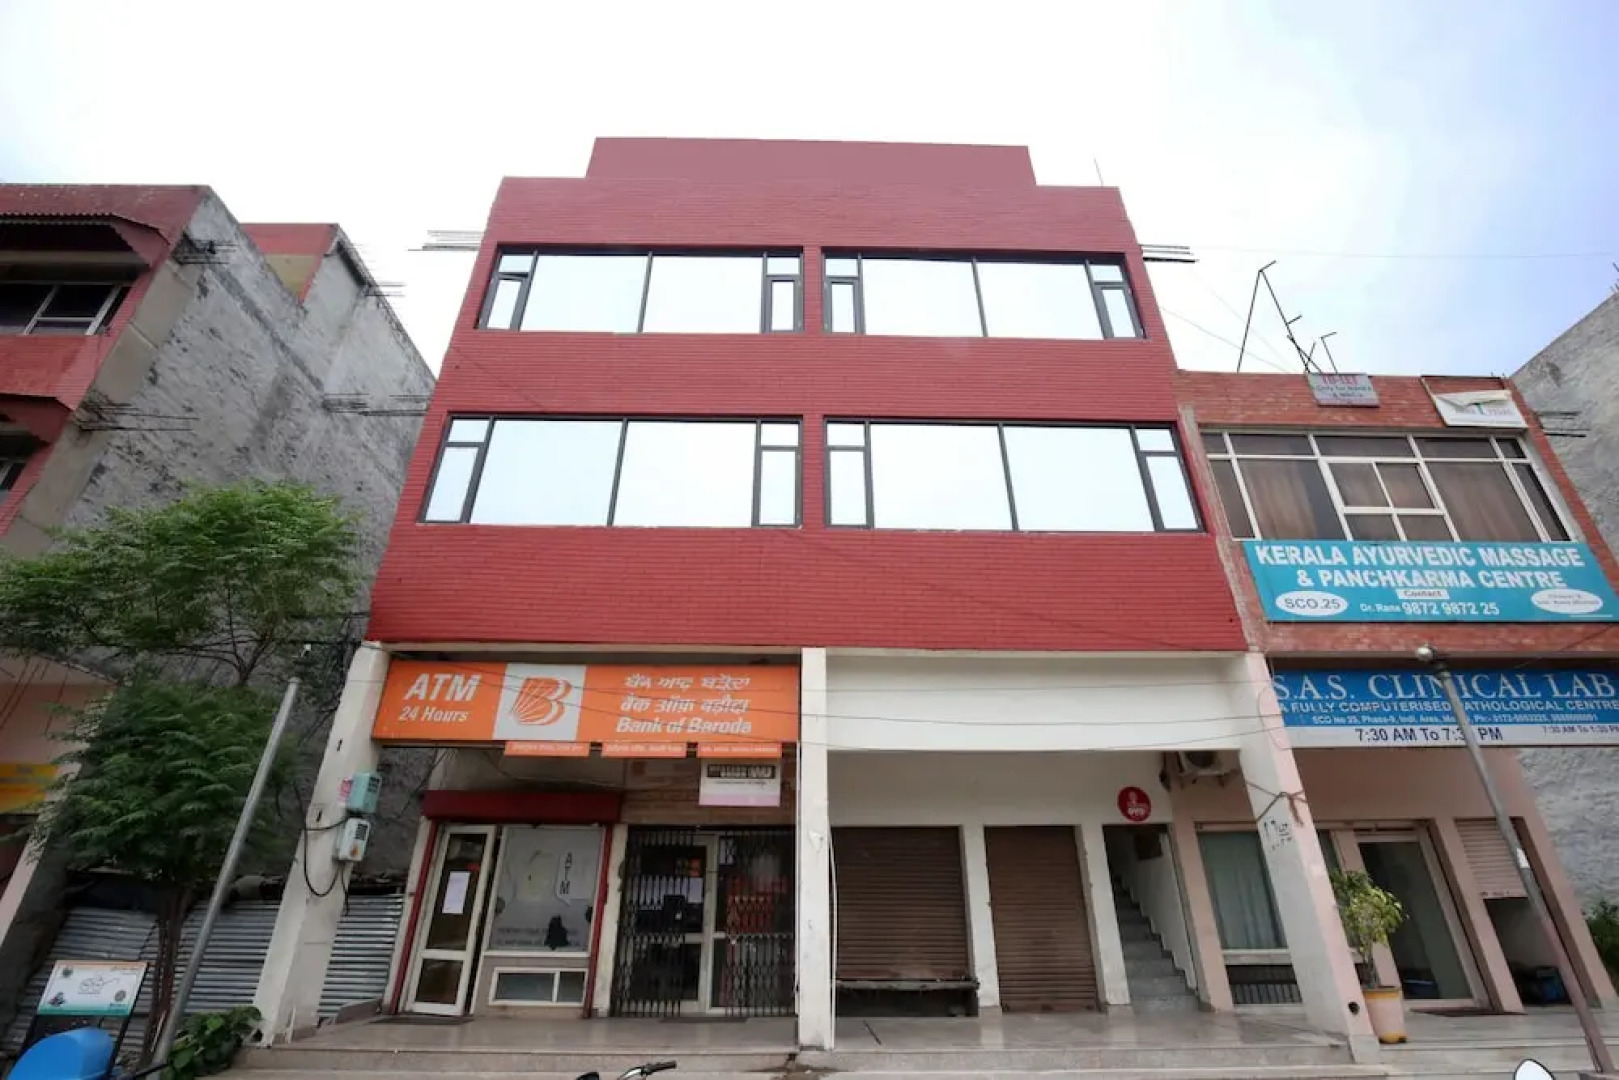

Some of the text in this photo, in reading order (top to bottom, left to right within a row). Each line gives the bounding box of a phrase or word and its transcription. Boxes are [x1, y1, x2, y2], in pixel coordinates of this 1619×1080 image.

[1255, 545, 1585, 568] KERALA AYURVEDIC MASSAGE
[1297, 569, 1567, 589] & PANCHKARMA CENTRE
[1401, 601, 1440, 615] 9872
[1441, 602, 1478, 615] 9872
[1480, 602, 1500, 615] 25
[403, 673, 482, 701] ATM
[1274, 675, 1355, 700] S.A.S.
[1543, 673, 1616, 698] LAB
[398, 705, 469, 722] 24 Hours
[1292, 702, 1335, 713] FULLY
[1339, 701, 1451, 713] COMPUTERISED
[1460, 700, 1564, 711] ATHOLOGICAL
[1565, 700, 1619, 710] CENTRE
[616, 716, 752, 734] Bank of Baroda
[1355, 728, 1503, 741] 7:30 AM To 7:3 PM
